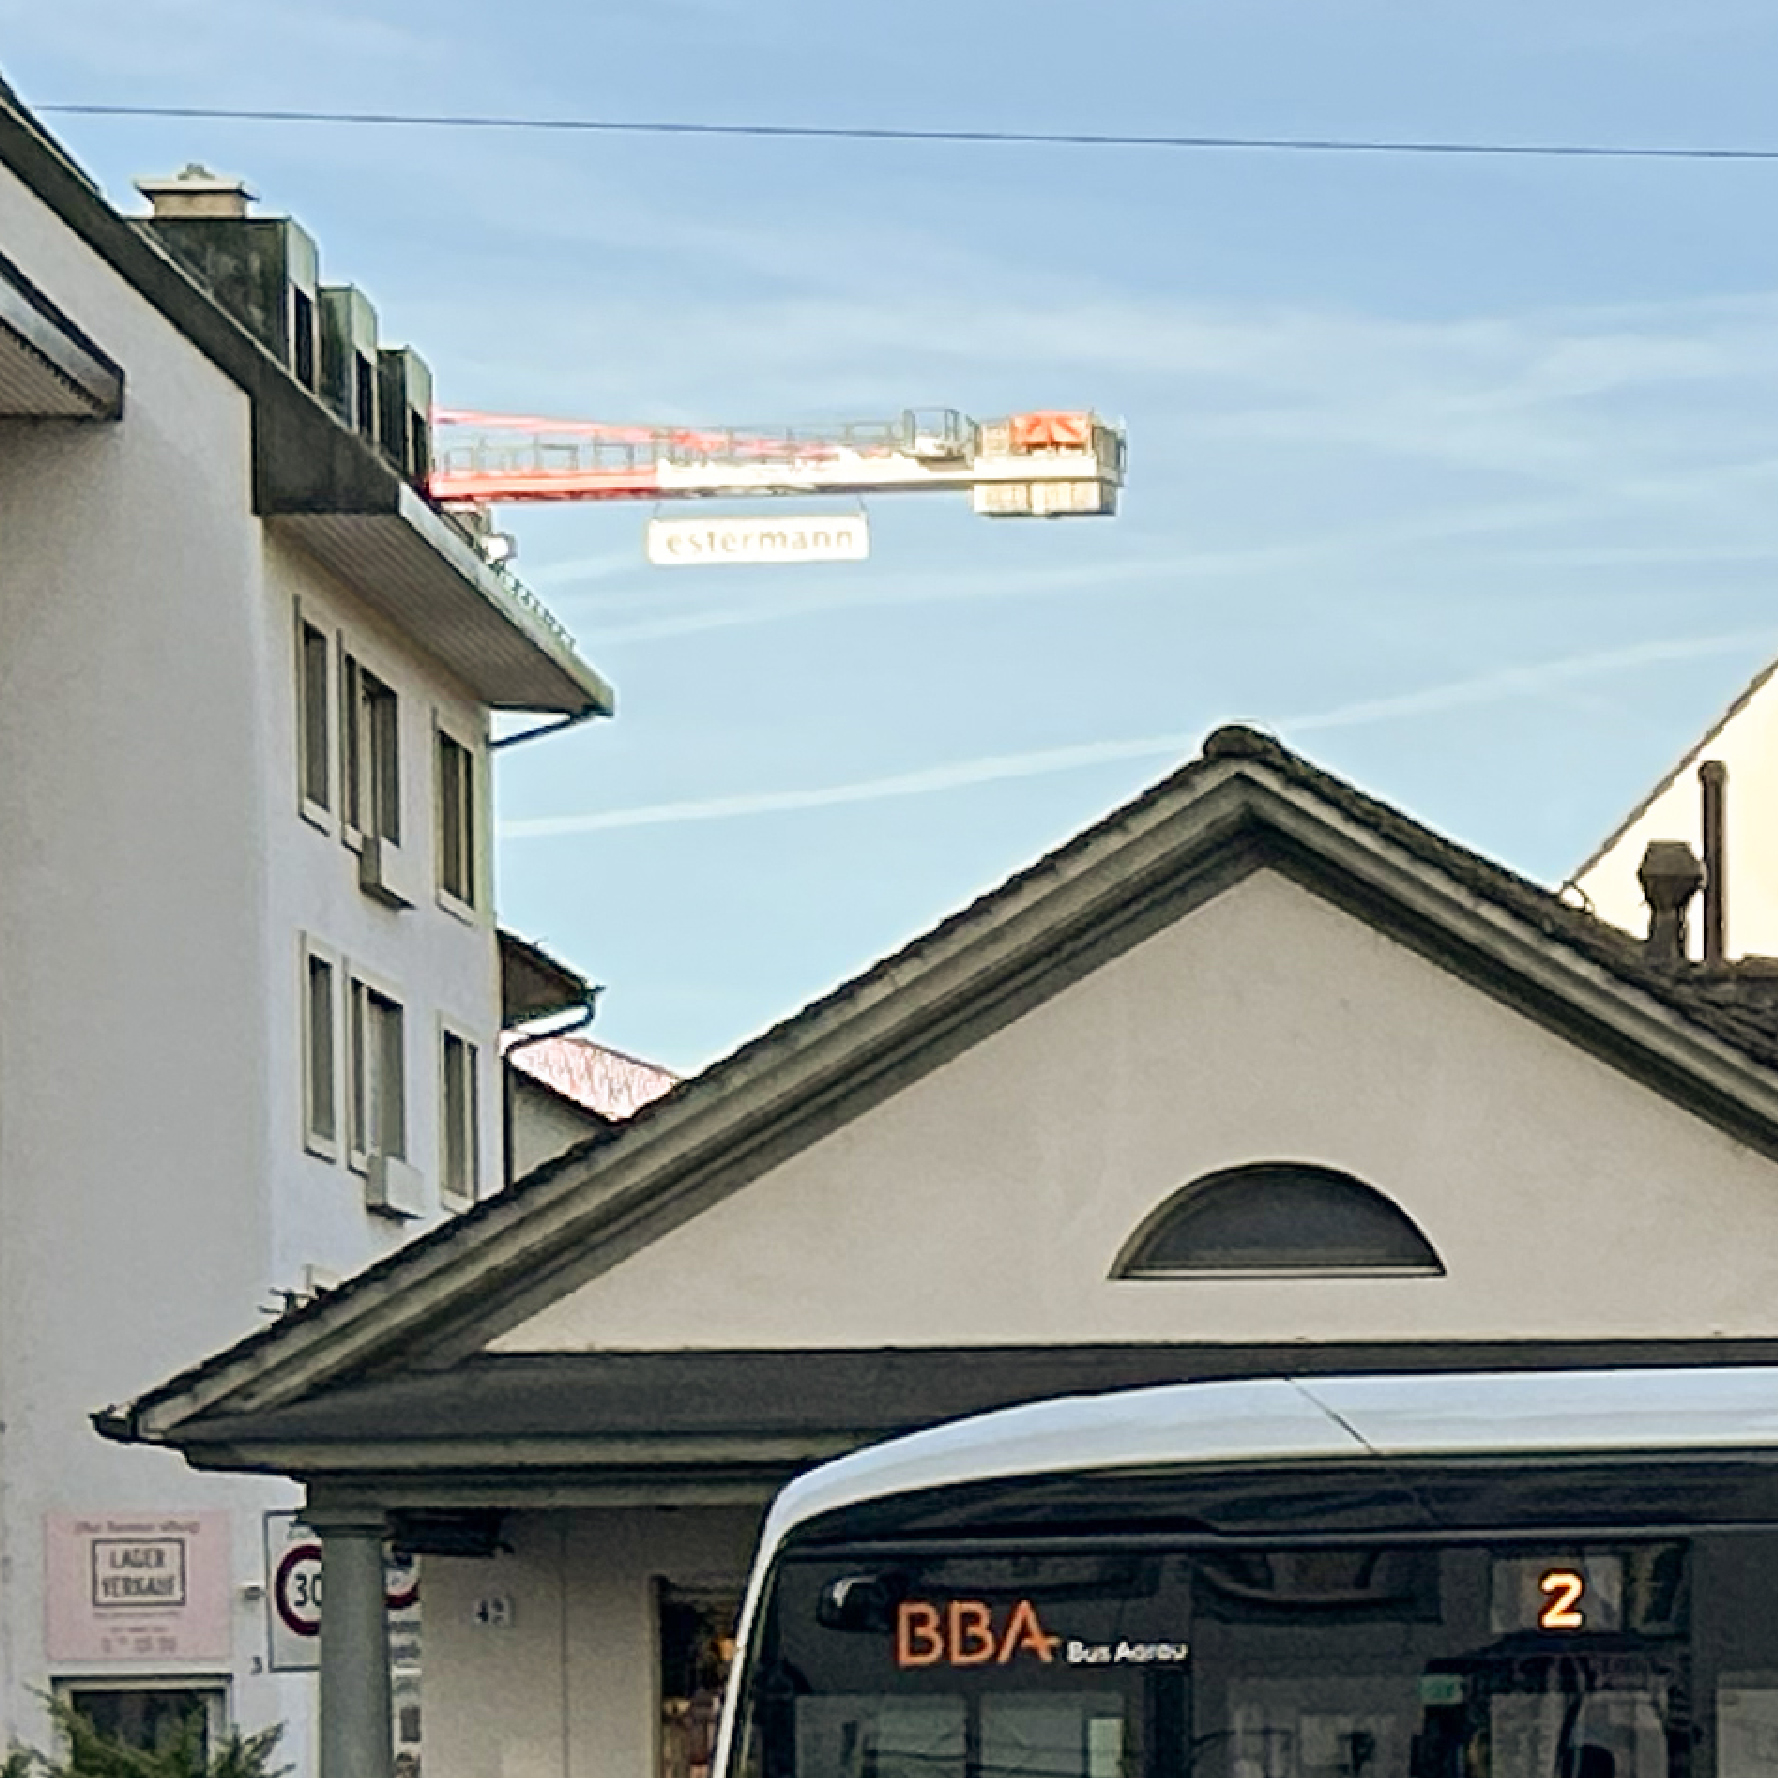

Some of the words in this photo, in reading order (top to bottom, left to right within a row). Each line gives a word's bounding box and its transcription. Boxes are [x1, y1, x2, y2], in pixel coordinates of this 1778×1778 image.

[665, 531, 853, 555] estermann
[1540, 1572, 1585, 1630] 2
[898, 1599, 1064, 1666] BBA
[1066, 1640, 1112, 1663] Bus
